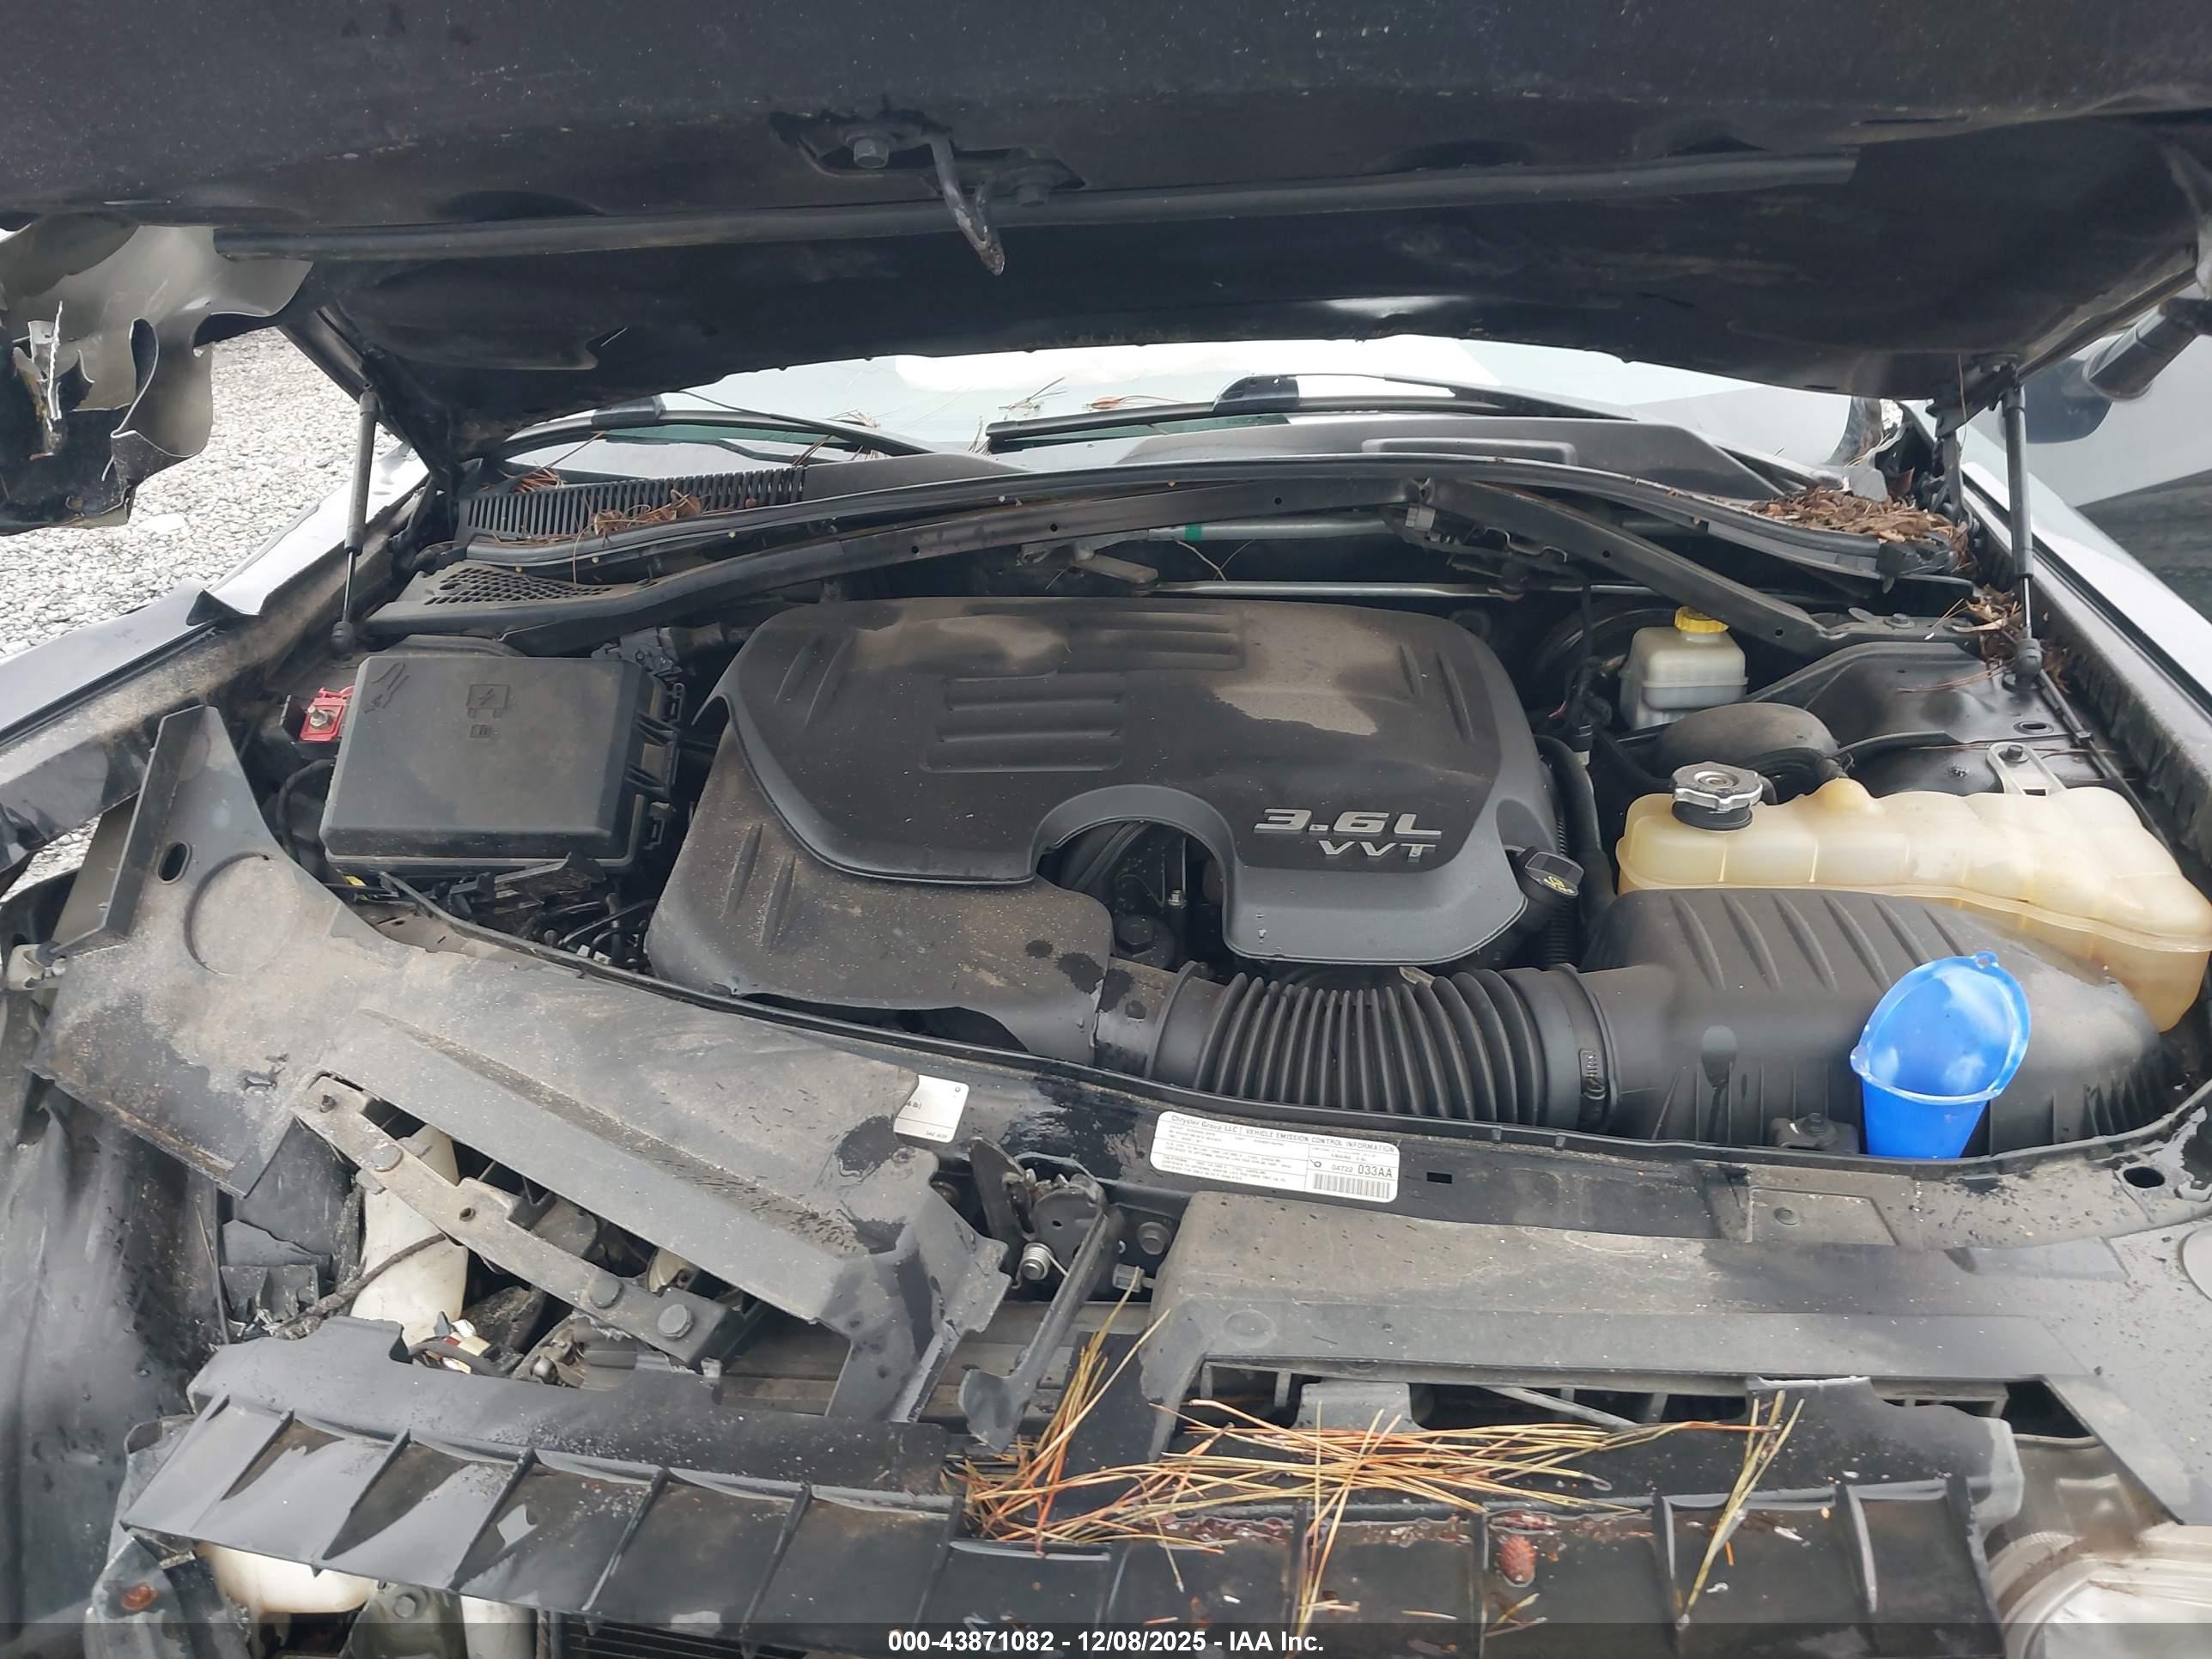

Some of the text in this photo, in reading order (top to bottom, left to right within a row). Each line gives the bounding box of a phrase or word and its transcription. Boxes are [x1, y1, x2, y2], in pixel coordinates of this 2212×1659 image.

[1253, 808, 1443, 837] 3.6L
[1318, 840, 1437, 860] VVT
[1200, 1120, 1224, 1132] Group
[1224, 1124, 1238, 1133] LLC
[1245, 1127, 1274, 1139] VEHICLE
[1276, 1131, 1310, 1143] EMISSION
[1311, 1135, 1344, 1147] CONTROL
[1346, 1139, 1395, 1153] INFORMATION
[1358, 1164, 1393, 1178] 033AA
